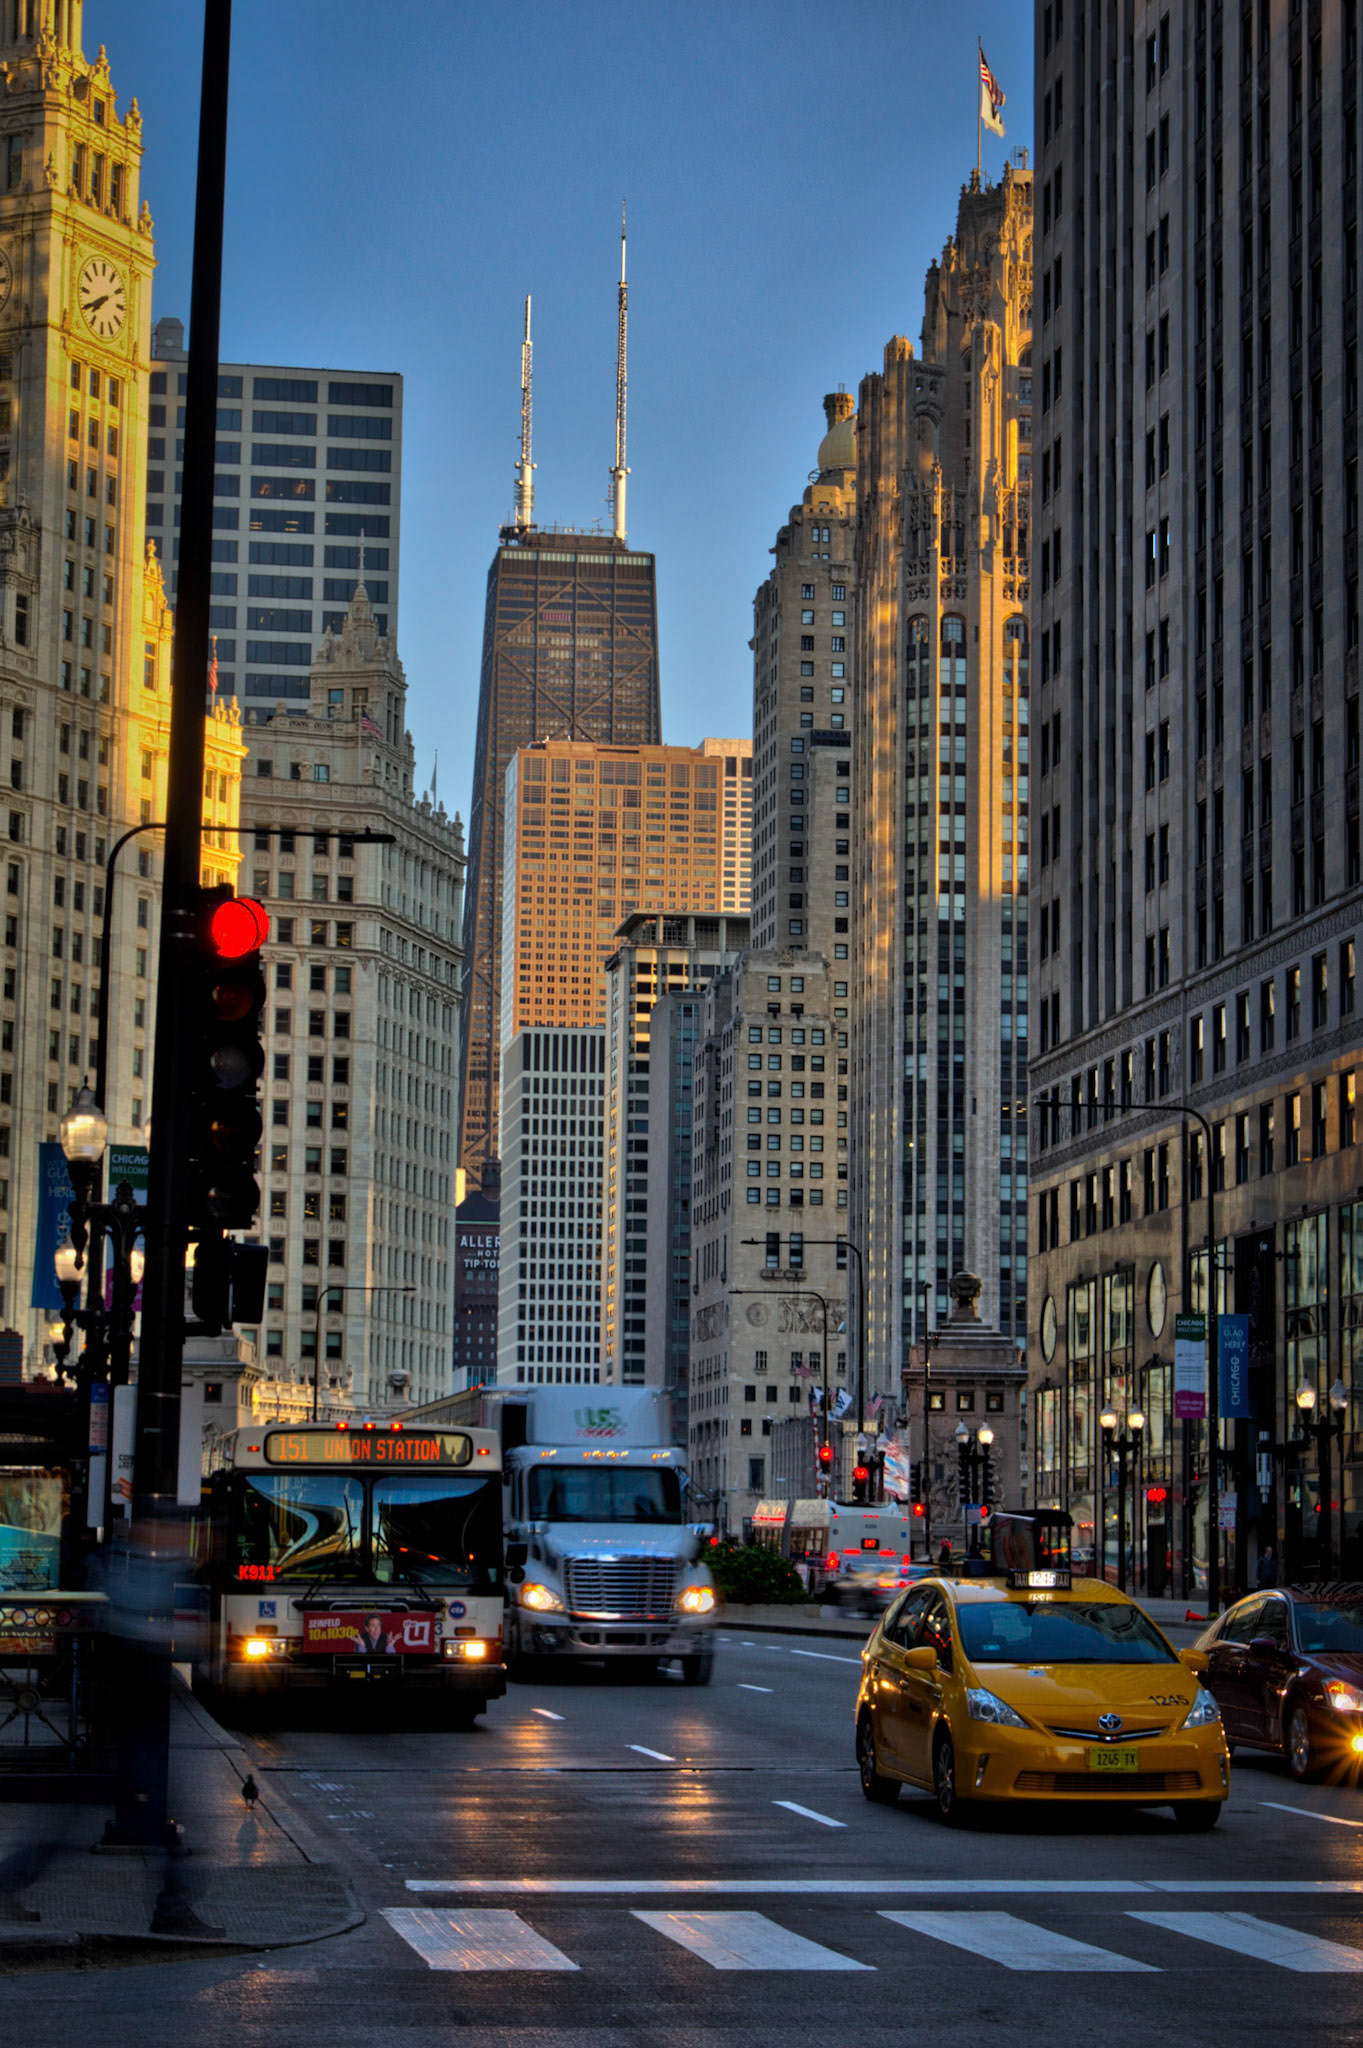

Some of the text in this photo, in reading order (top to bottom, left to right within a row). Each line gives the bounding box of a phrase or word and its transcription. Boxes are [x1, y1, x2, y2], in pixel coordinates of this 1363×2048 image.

[112, 1154, 149, 1165] CHICAG
[477, 1250, 500, 1258] HOT
[1177, 1319, 1204, 1327] CHICAGO
[1223, 1329, 1244, 1337] GLAD
[1231, 1357, 1240, 1406] CHICAGO
[279, 1435, 440, 1460] 151 UNION STATION
[1014, 1572, 1070, 1587] TAXI 1245 TAXI
[308, 1618, 341, 1628] SEINFELD
[1148, 1694, 1190, 1706] 1245
[1124, 1753, 1135, 1766] TX
